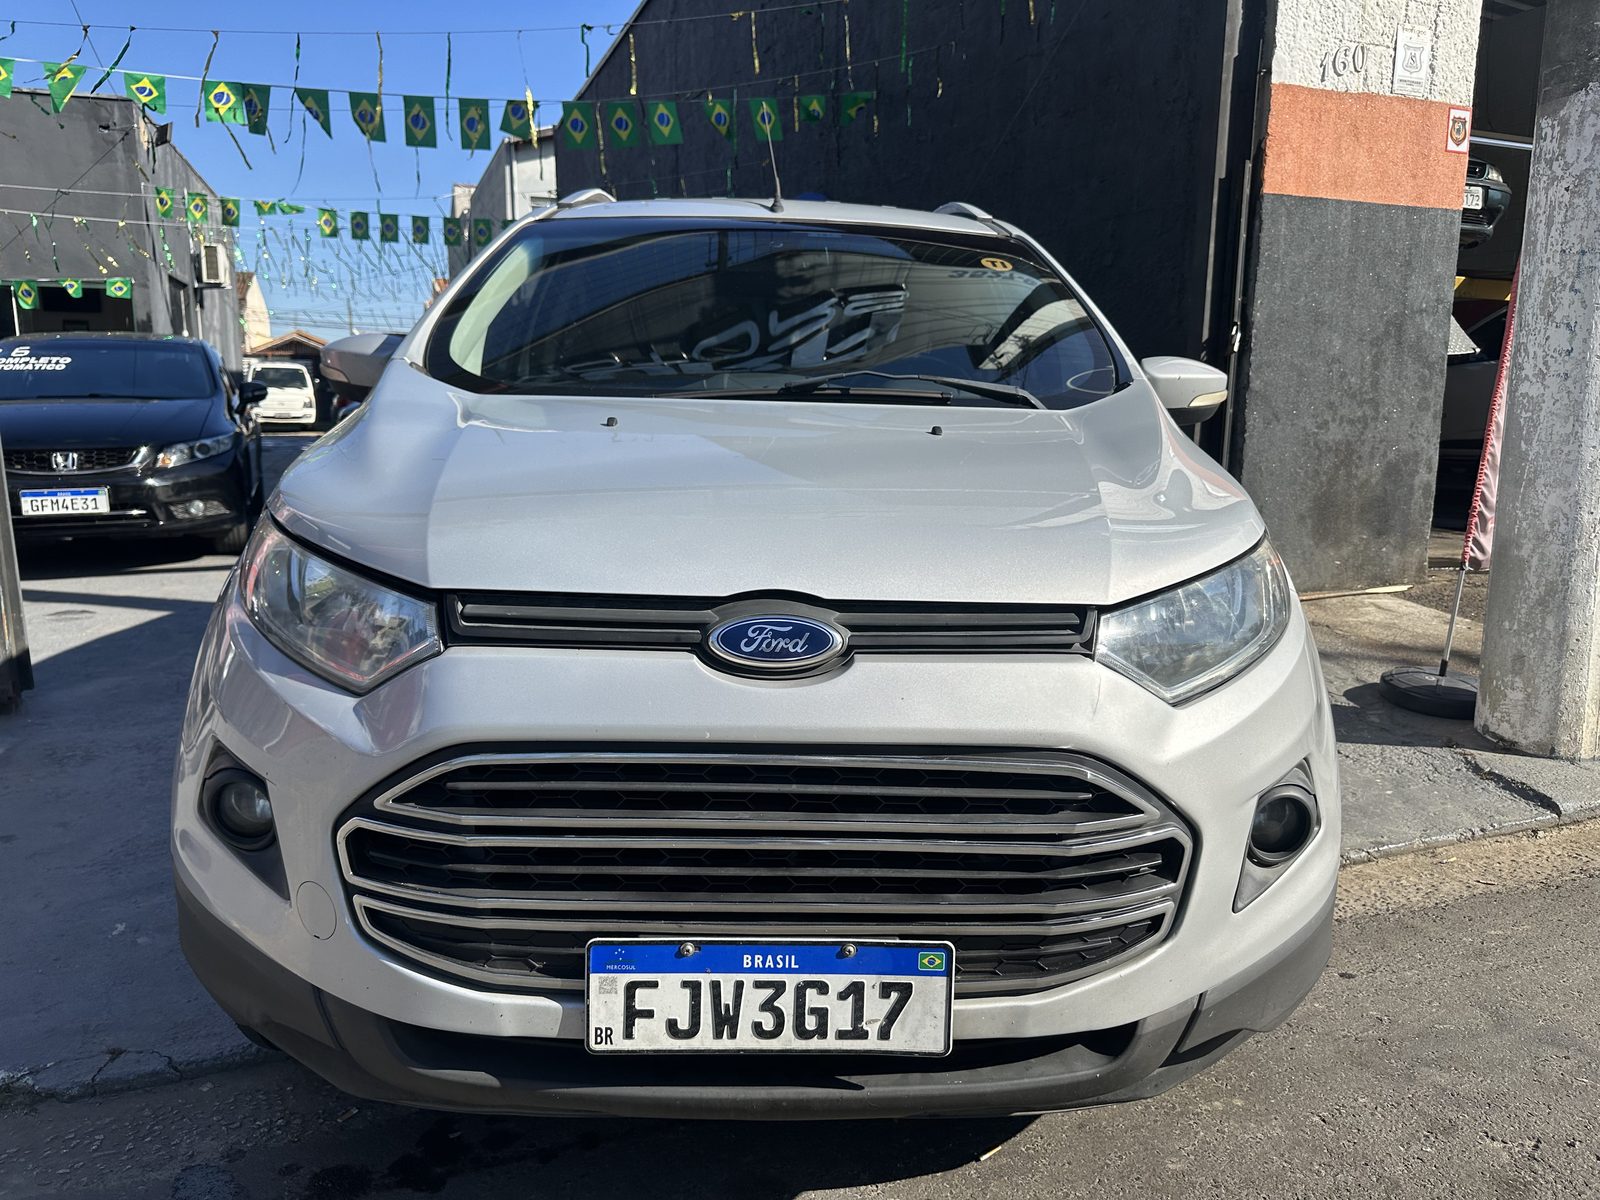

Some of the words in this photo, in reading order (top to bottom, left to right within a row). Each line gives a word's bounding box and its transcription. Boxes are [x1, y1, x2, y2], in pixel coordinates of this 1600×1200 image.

[1319, 44, 1367, 83] 160
[1464, 193, 1480, 207] 172
[30, 497, 99, 512] GFM4E31
[740, 624, 810, 653] Ford
[743, 954, 799, 969] BRASIL
[622, 979, 914, 1041] FJW3G17
[594, 1026, 614, 1046] BR
